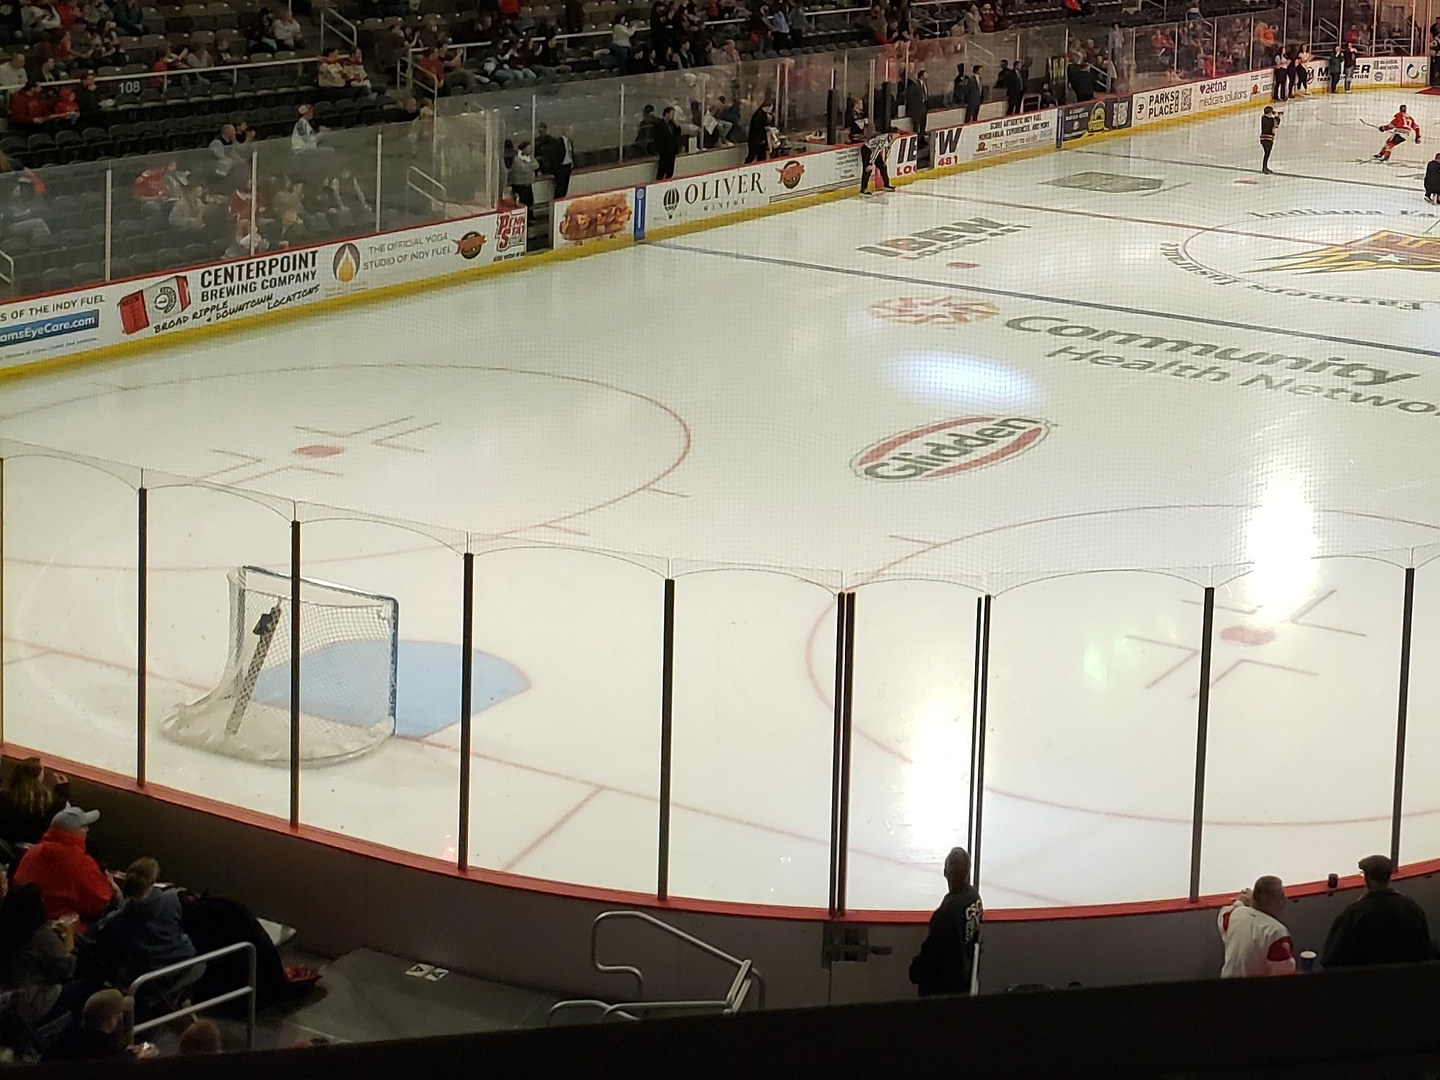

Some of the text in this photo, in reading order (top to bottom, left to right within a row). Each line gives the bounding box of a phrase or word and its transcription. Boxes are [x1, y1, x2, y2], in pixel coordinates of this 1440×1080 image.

[119, 80, 141, 94] 108
[1149, 91, 1175, 106] PARKS
[1206, 80, 1227, 94] aetna
[1149, 102, 1175, 119] PLACE
[938, 156, 959, 168] 481
[685, 171, 764, 205] OLIVER
[368, 231, 449, 255] THE OFFICIAL YOGA
[856, 216, 1009, 257] IBEW
[200, 249, 319, 289] CENTERPOINT
[362, 245, 453, 271] STUDIO OF INDY FUEL
[201, 280, 257, 303] BREWING
[260, 269, 317, 291] COMPANY
[267, 283, 321, 311] LOCATIONS
[11, 308, 26, 320] OF
[29, 304, 50, 317] THE
[52, 299, 78, 313] INDY
[80, 294, 105, 308] FUEL
[153, 300, 229, 334] BROAD RIPPLE
[215, 292, 274, 321] DOWNTOWN
[1005, 314, 1419, 387] Community
[1045, 344, 1232, 384] Health
[864, 417, 1040, 480] Glidden
